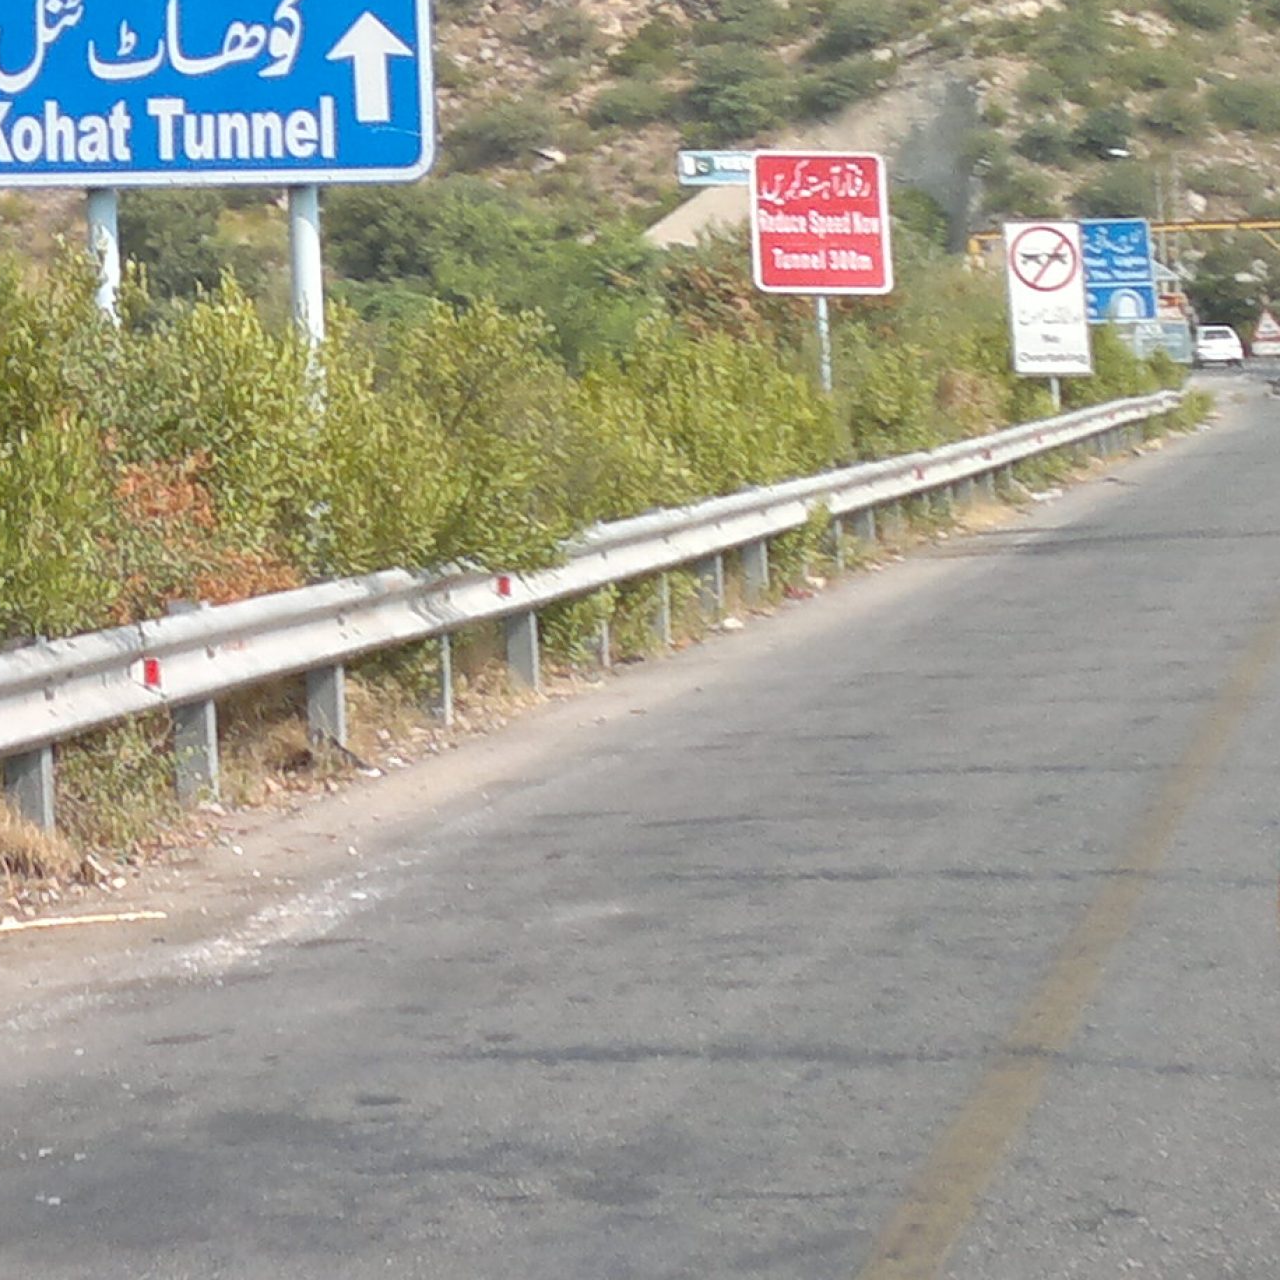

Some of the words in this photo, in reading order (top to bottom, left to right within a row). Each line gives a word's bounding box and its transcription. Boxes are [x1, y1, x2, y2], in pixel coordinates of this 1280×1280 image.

[148, 97, 335, 161] Tunnel
[808, 210, 851, 238] Speed
[771, 247, 826, 270] Tunnel
